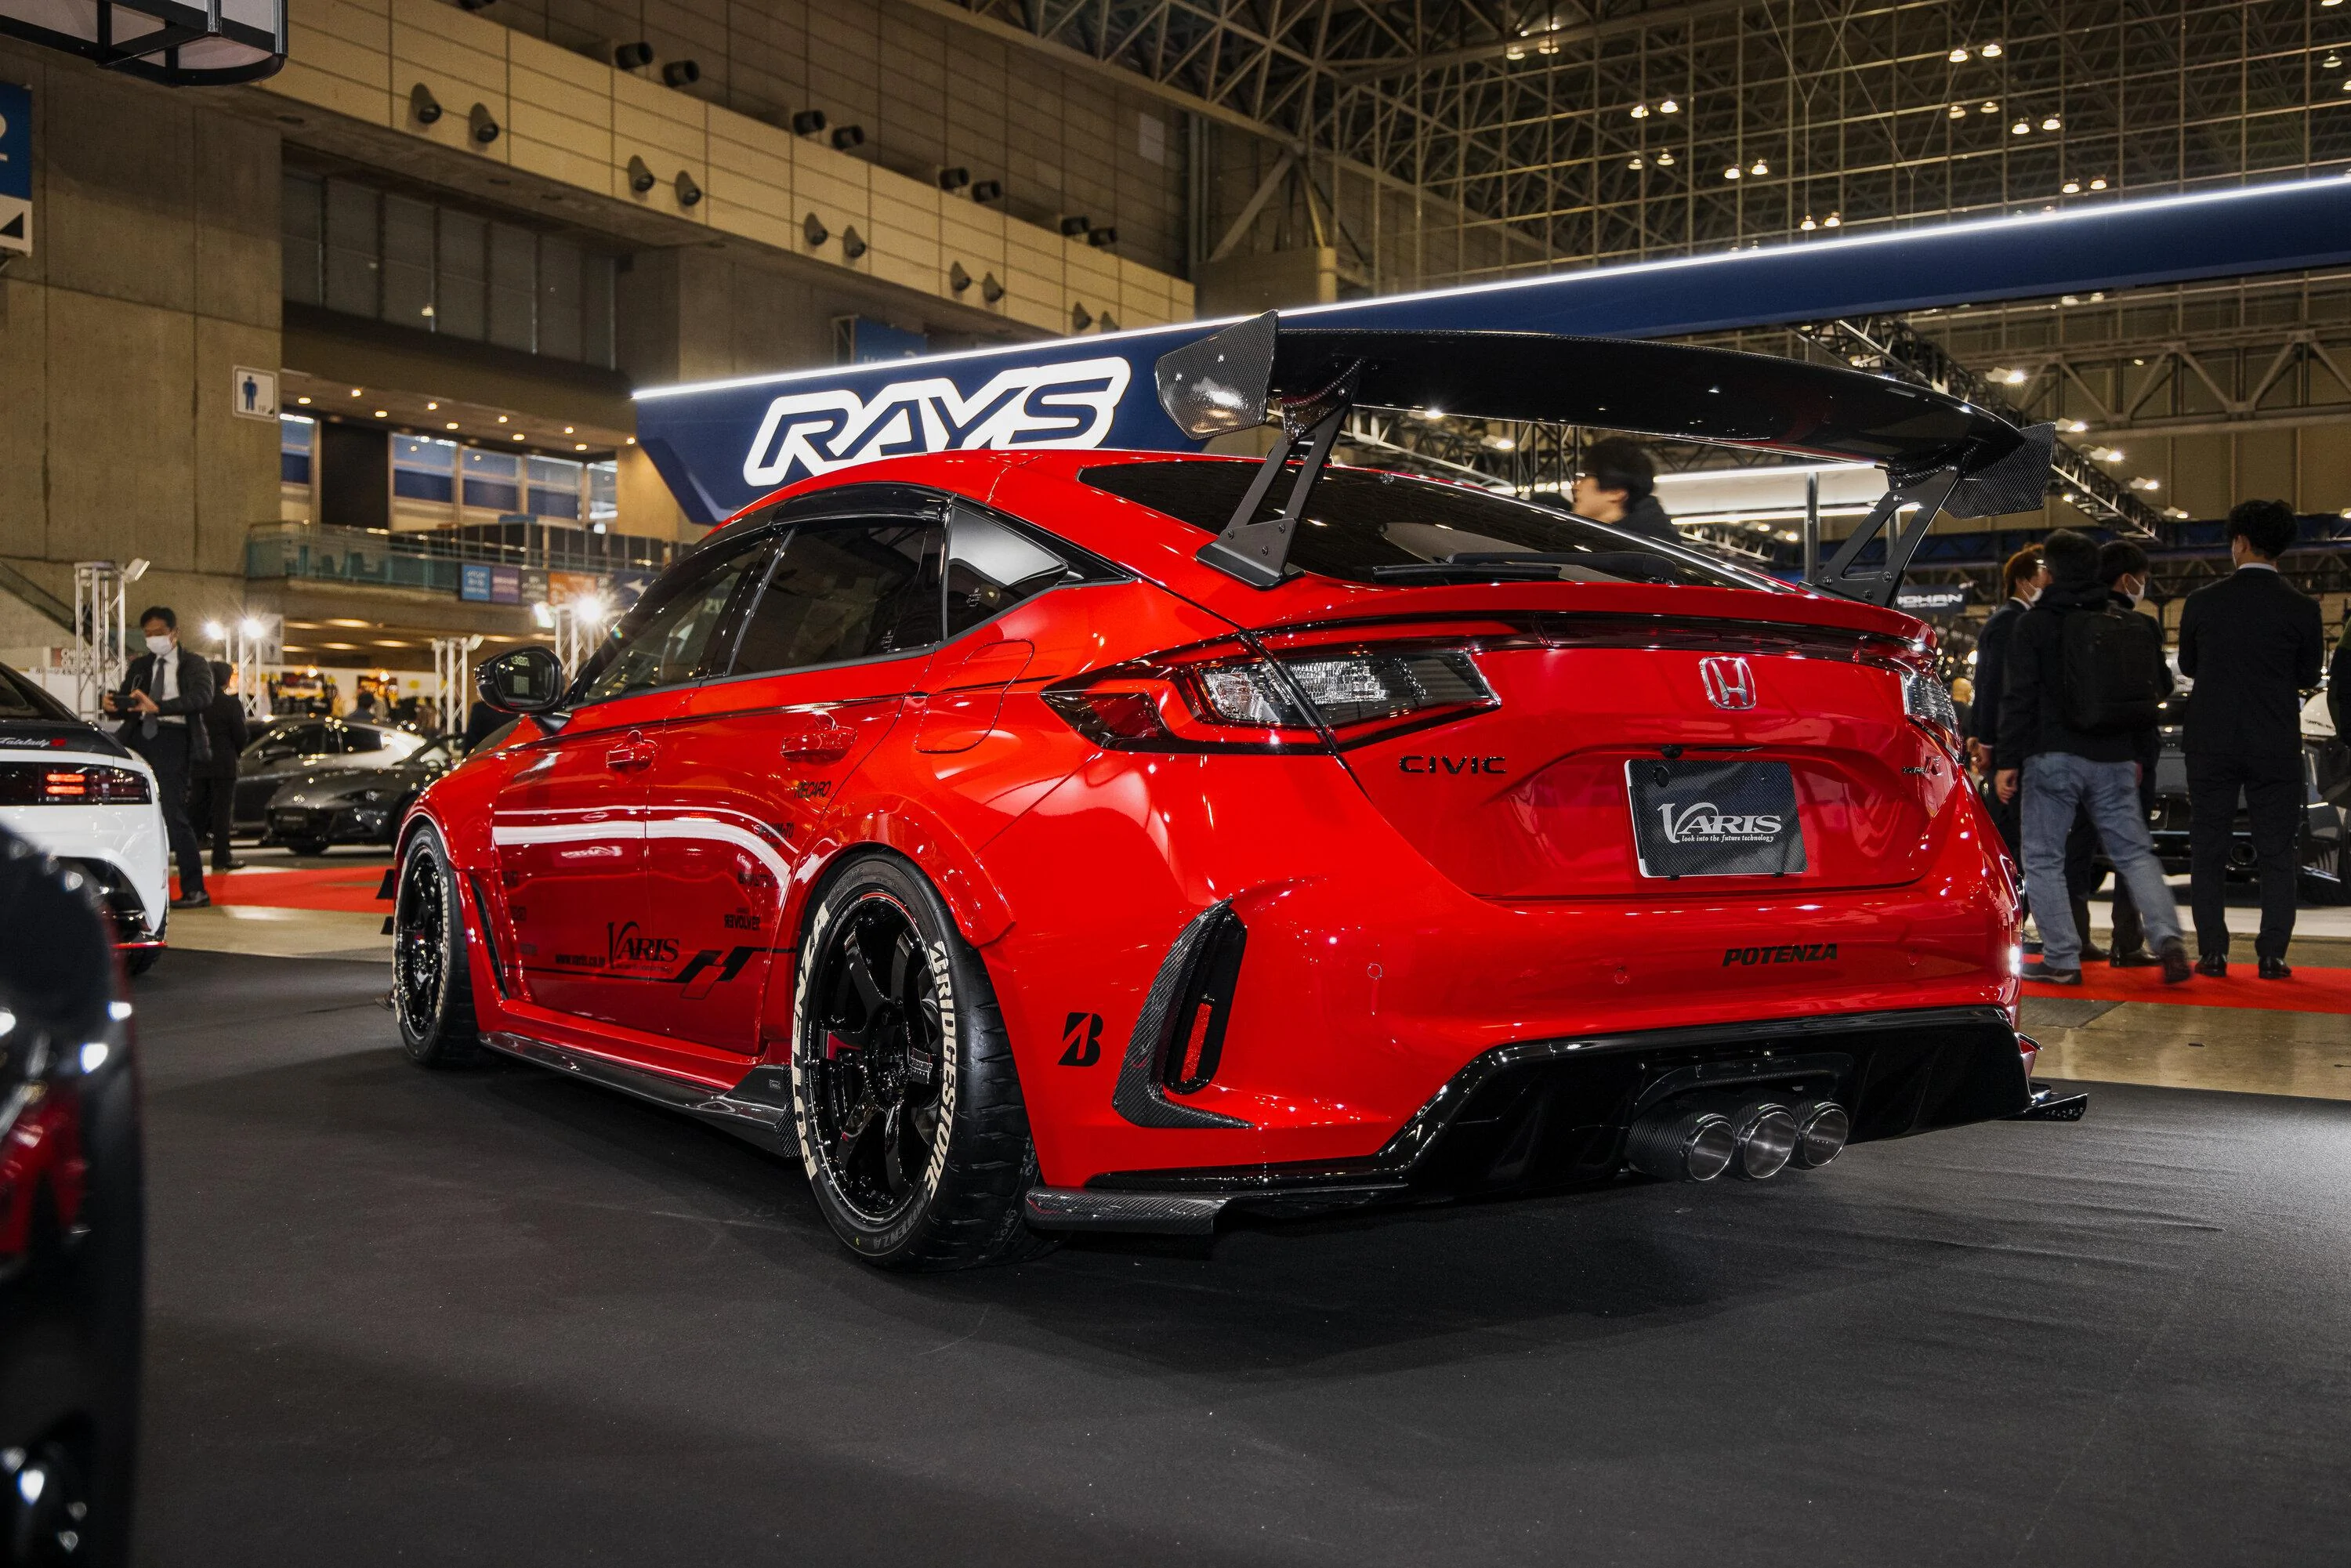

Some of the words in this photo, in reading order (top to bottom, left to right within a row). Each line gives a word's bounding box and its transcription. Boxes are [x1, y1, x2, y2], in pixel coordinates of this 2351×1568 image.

[743, 357, 1131, 487] RAYS
[1398, 755, 1507, 774] CIVIC
[795, 780, 831, 798] RECARO
[1657, 802, 1782, 844] VARIS
[1721, 835, 1741, 843] future
[1741, 834, 1775, 842] technology
[607, 921, 680, 969] VARIS
[1722, 943, 1838, 967] POTENZA
[924, 940, 958, 1200] BRIDGESTONE
